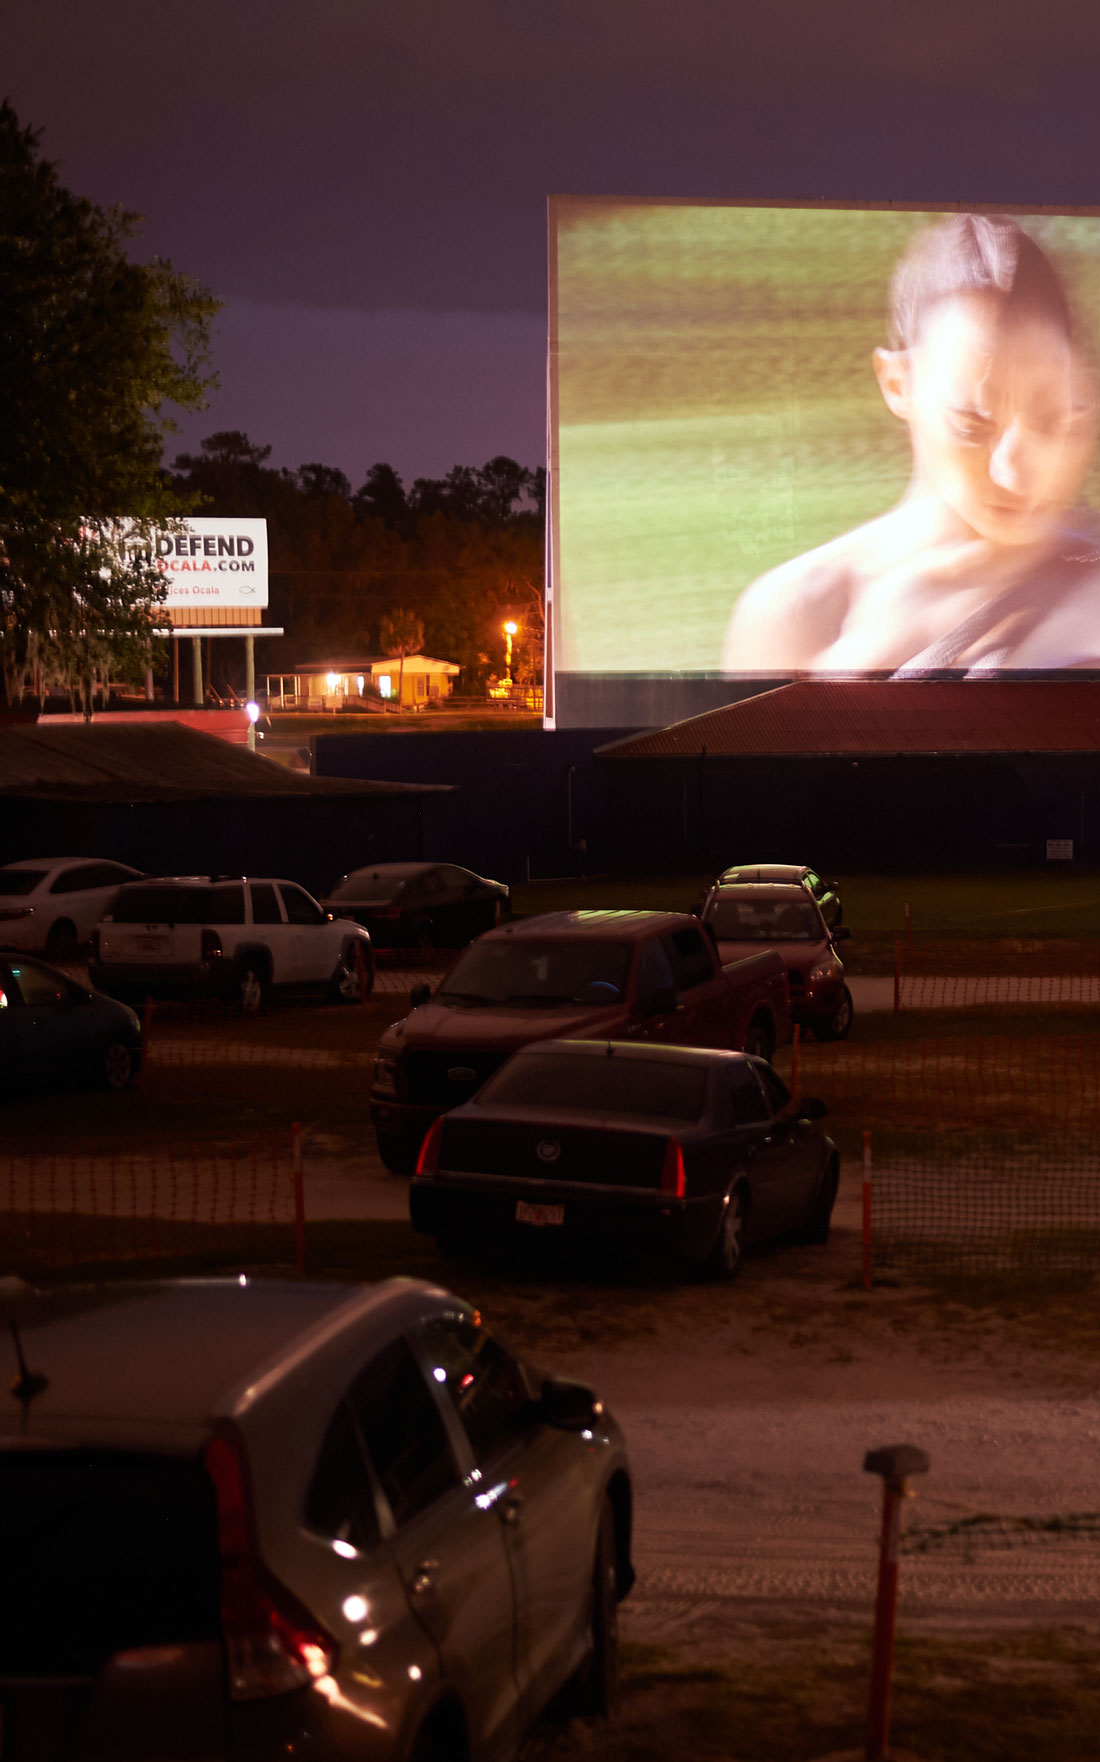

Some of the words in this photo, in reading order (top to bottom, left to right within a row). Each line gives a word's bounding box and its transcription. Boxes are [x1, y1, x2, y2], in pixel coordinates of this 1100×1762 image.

[156, 535, 254, 557] DEFEND
[157, 560, 255, 572] OCALA.COM
[192, 585, 220, 595] Ocala
